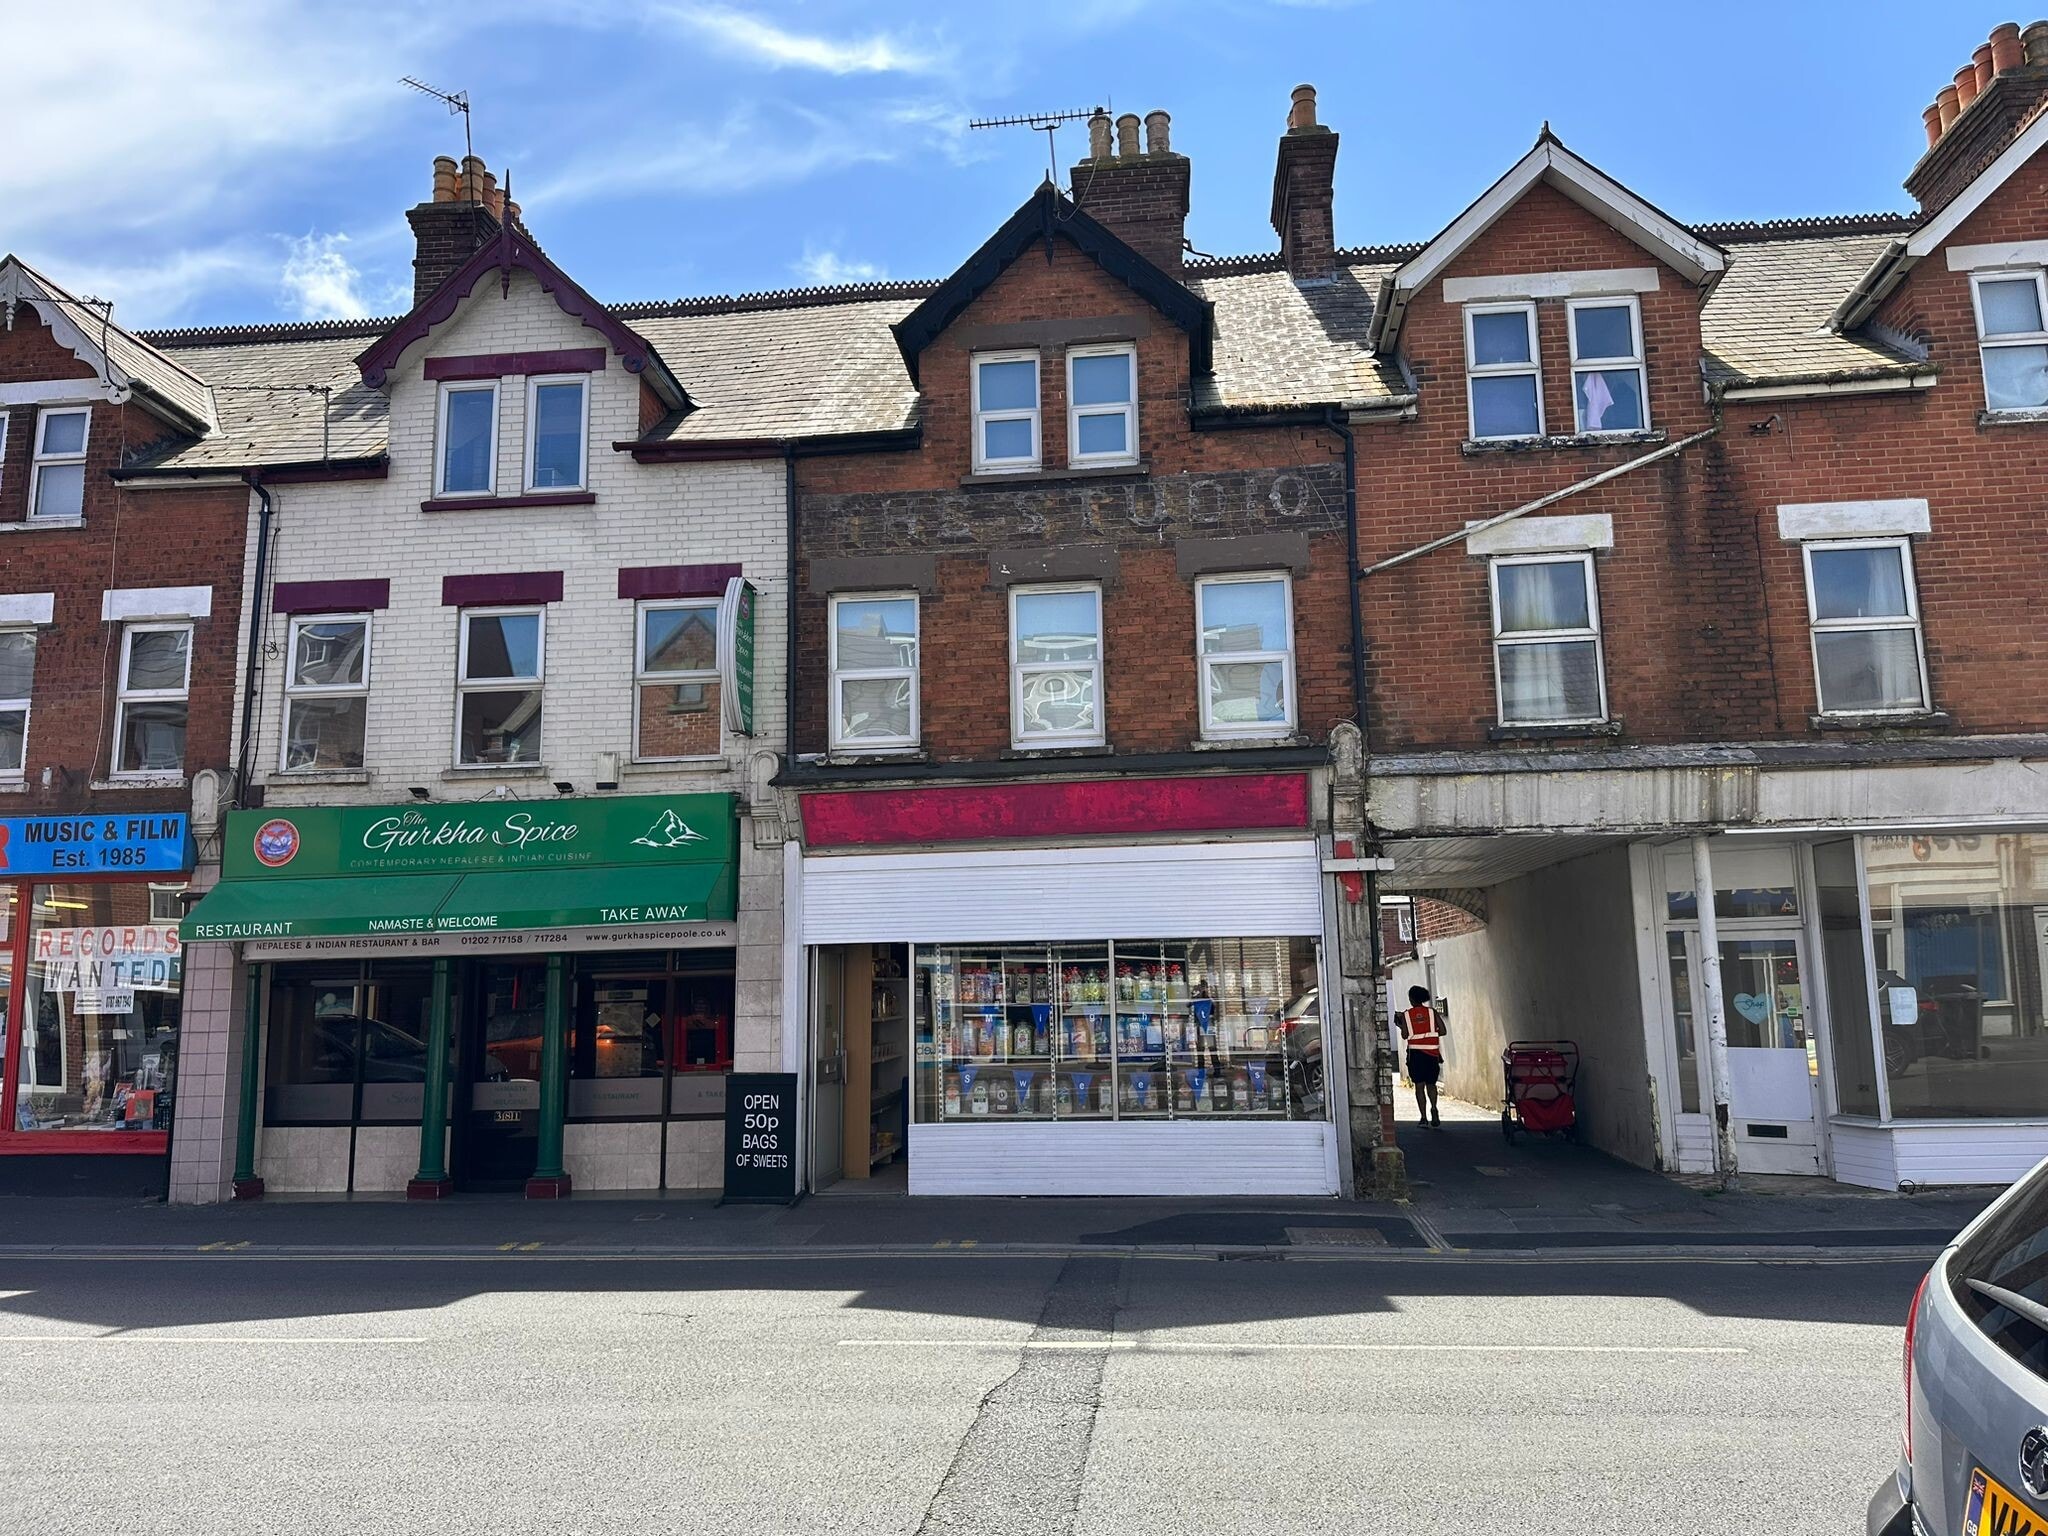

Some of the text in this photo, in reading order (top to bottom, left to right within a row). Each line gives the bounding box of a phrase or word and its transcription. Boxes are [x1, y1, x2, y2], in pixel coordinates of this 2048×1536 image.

[402, 810, 427, 827] The
[25, 818, 179, 843] MUSIC & FILM
[363, 813, 579, 853] Gurkha Spice
[52, 847, 146, 868] Est. 1985
[600, 906, 689, 921] TAKE AWAY
[196, 922, 293, 937] RESTAURANT
[368, 915, 498, 930] NAMASTE & WELCOME
[38, 927, 179, 957] RECORDS
[461, 935, 489, 945] 01202
[492, 934, 523, 944] 717158
[534, 933, 568, 943] 717284
[585, 928, 727, 941] www.gurkhaspicepoole.co.uk
[256, 937, 440, 950] NEPALESE & INDIAN RESTAURANT & BAR
[49, 960, 166, 988] WANTED
[743, 1094, 780, 1110] OPEN
[744, 1113, 779, 1132] 50p
[742, 1133, 778, 1150] BAGS
[735, 1153, 788, 1168] OF SWEETS
